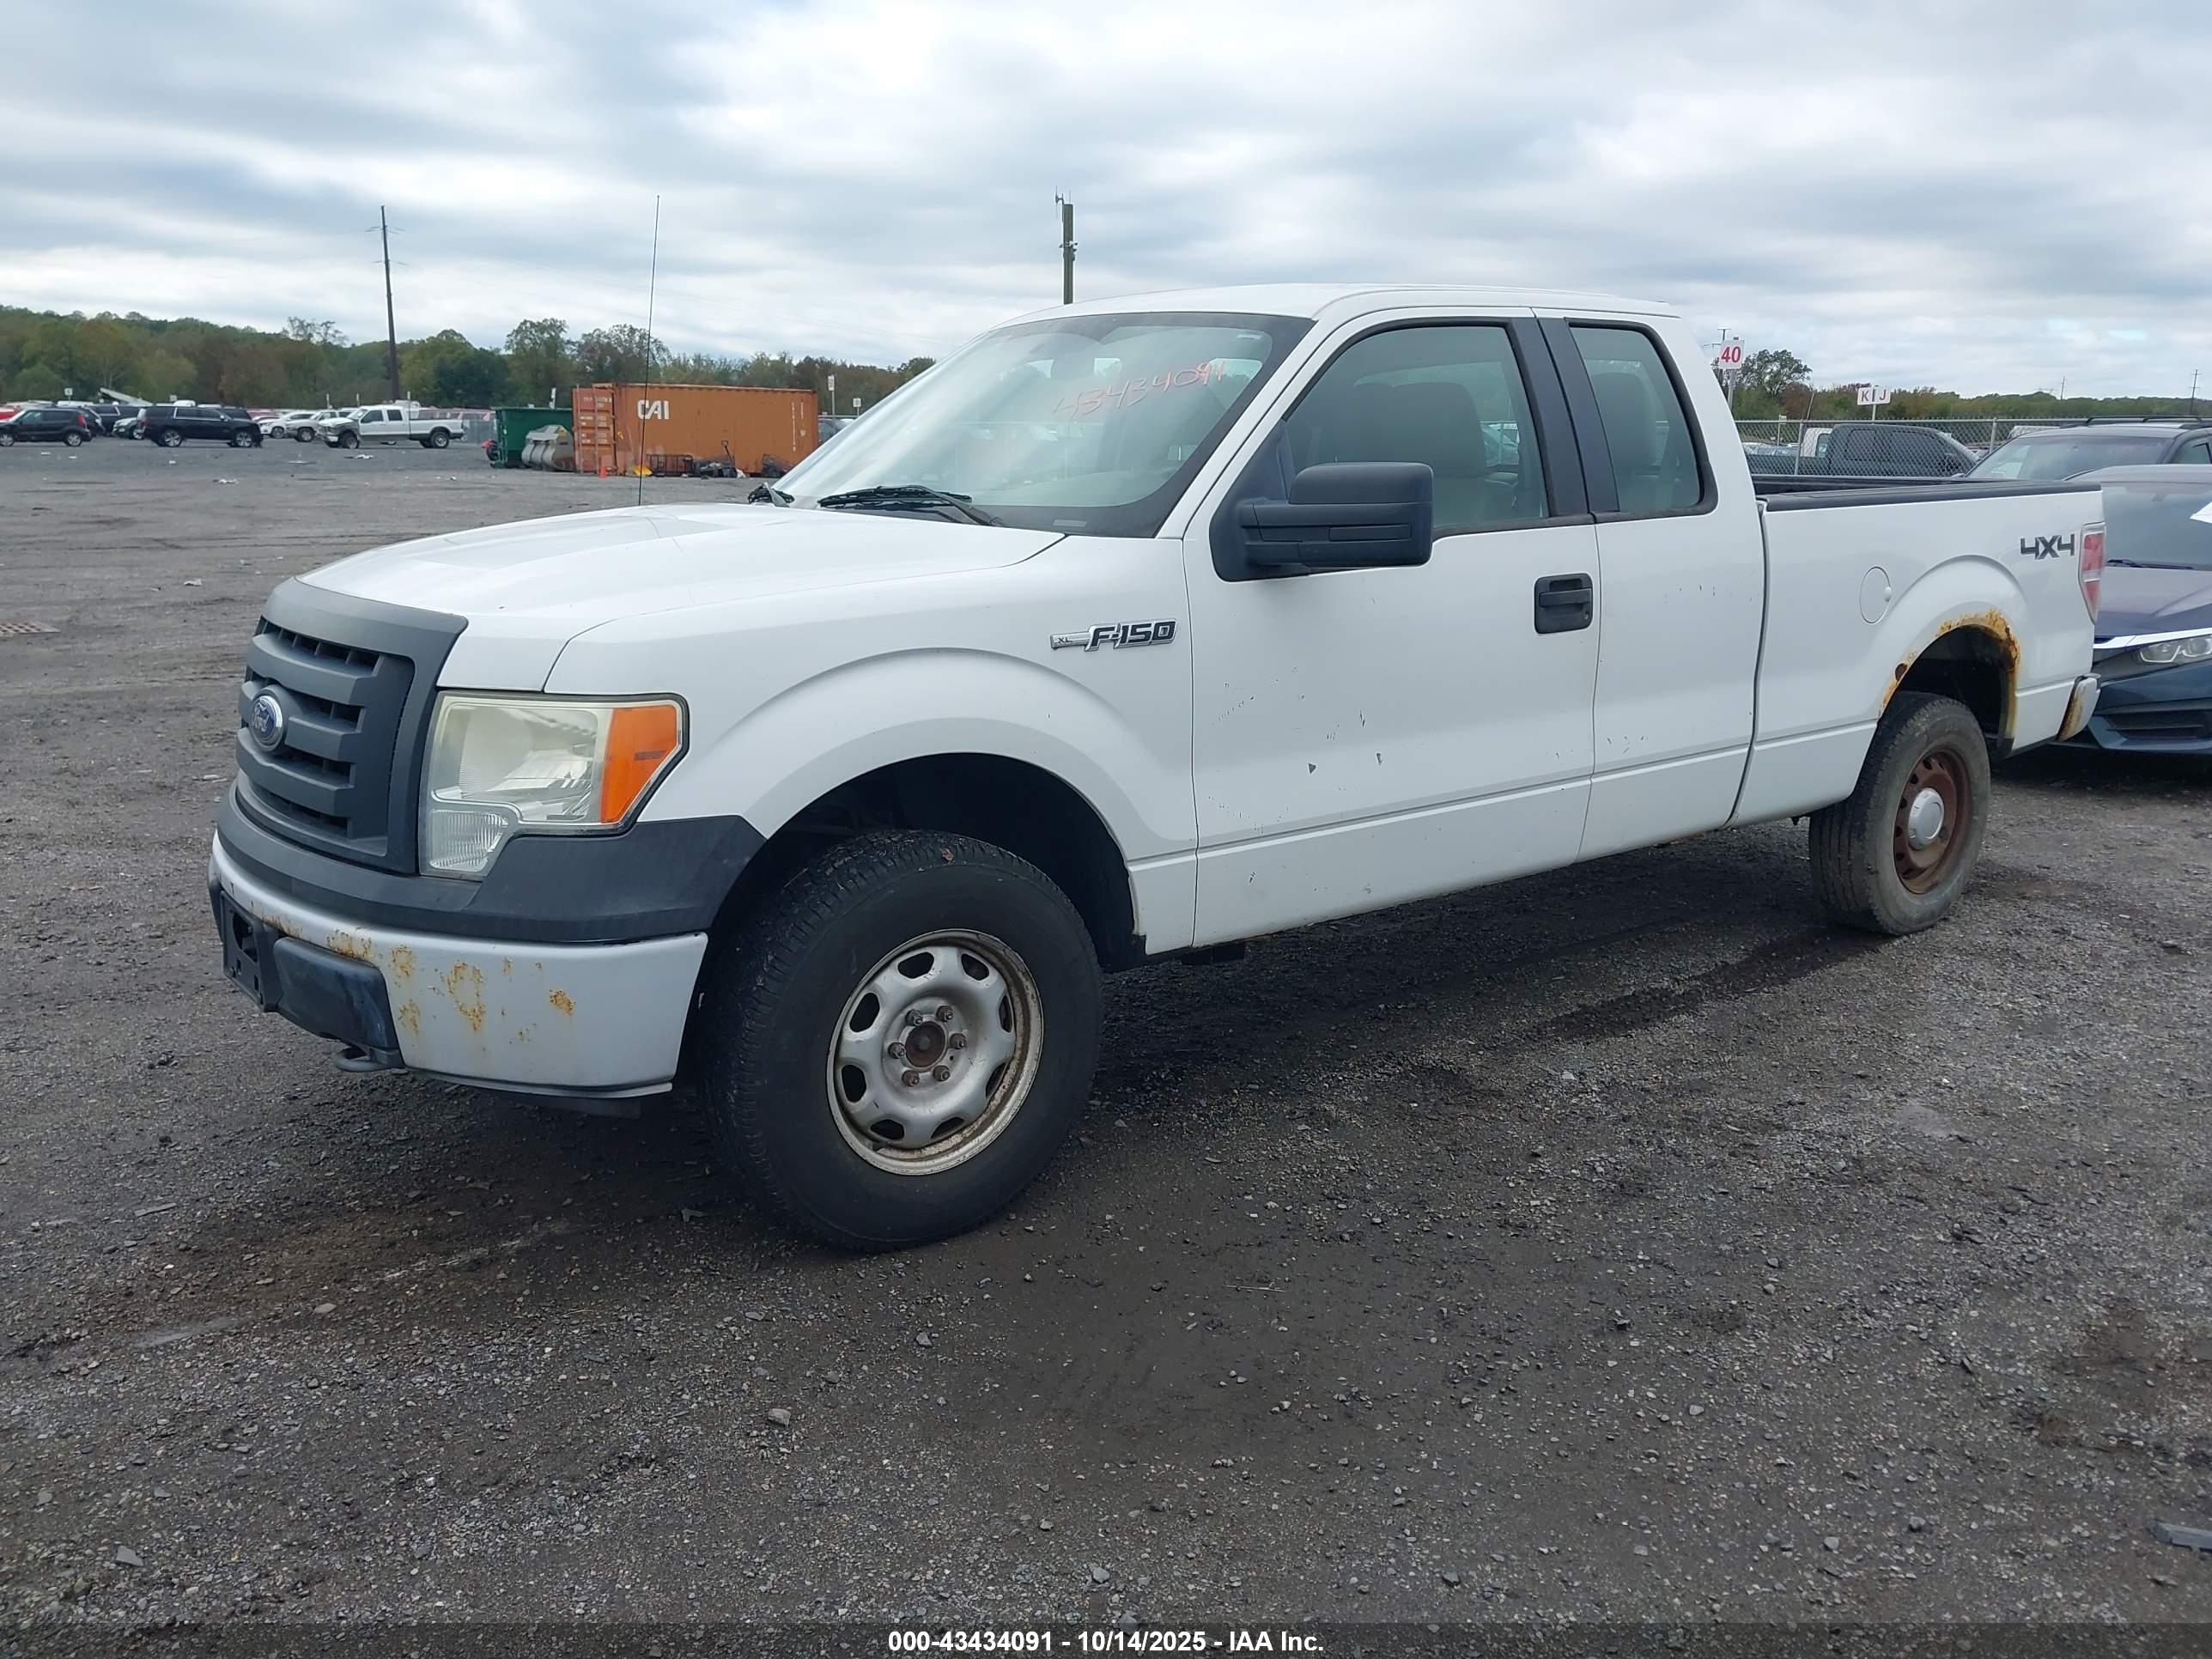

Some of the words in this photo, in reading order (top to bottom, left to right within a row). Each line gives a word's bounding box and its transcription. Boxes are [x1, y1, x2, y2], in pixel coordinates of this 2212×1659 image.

[1721, 346, 1741, 363] 40
[1053, 361, 1225, 420] 43434091
[1861, 390, 1869, 403] K
[1879, 389, 1887, 401] J
[637, 399, 670, 420] CAI
